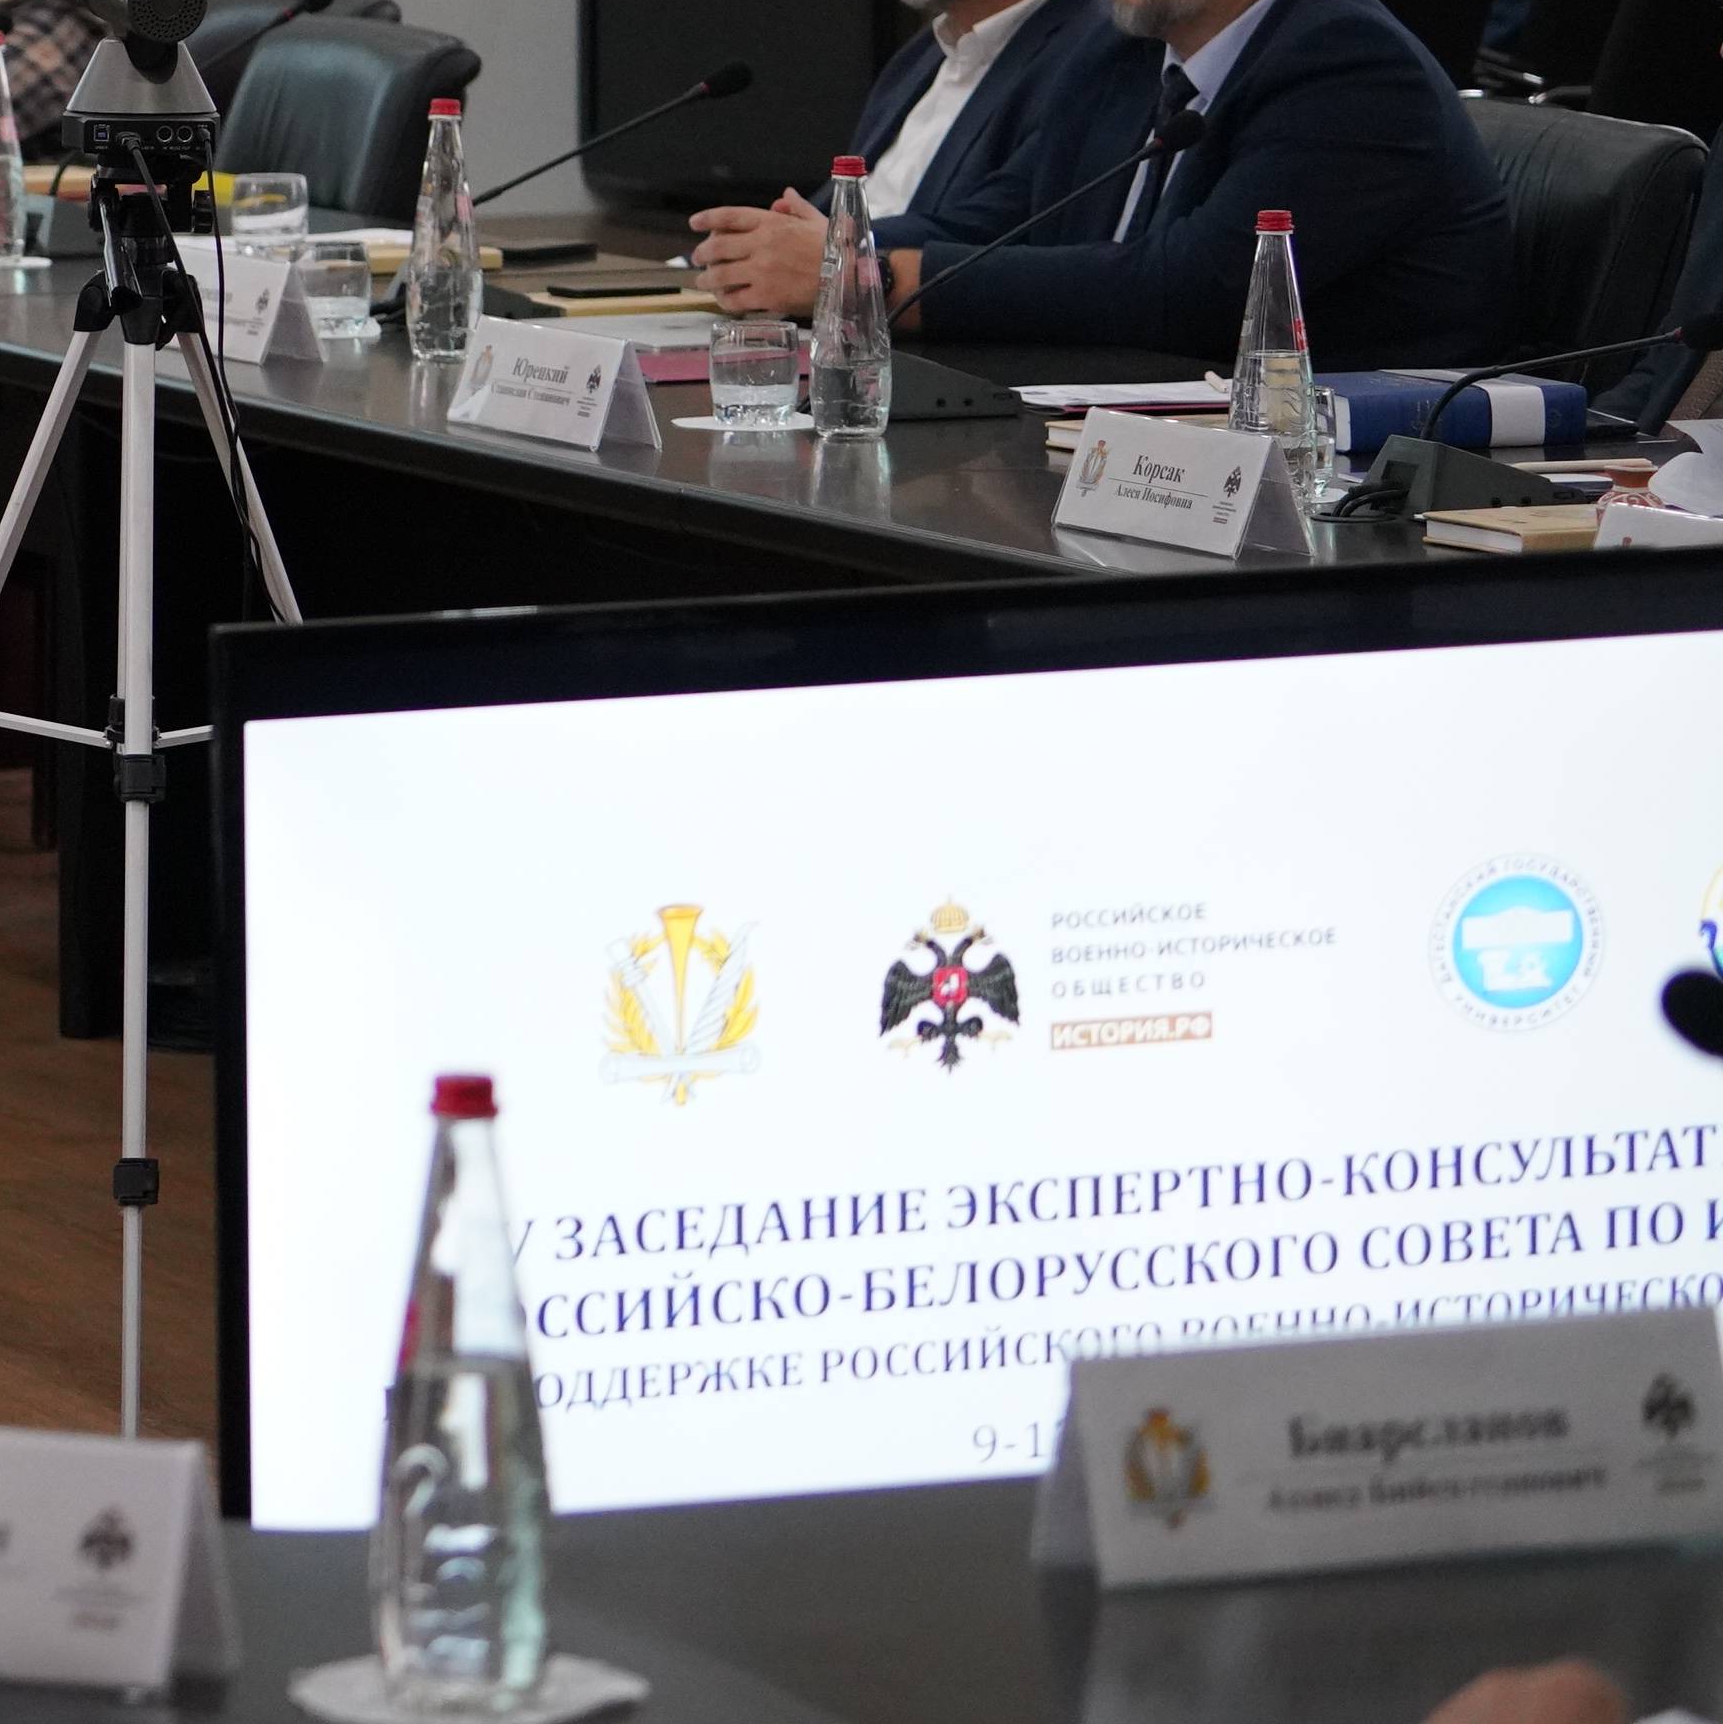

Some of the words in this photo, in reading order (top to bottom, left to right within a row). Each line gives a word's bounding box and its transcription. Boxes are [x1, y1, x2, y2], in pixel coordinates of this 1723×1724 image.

[512, 356, 570, 385] Юрецкий
[1132, 454, 1186, 484] Корсак
[1113, 484, 1141, 501] Алеся
[1142, 487, 1195, 510] Иосифовна
[1051, 901, 1206, 930] РОССИЙСКОЕ
[1051, 928, 1337, 965] ВОЕННО-ИСТОРИЧЕСКОЕ
[1051, 972, 1206, 999] ОБЩЕСТВО
[1053, 1015, 1210, 1047] ИСТОРИЯ.РФ
[554, 1187, 928, 1261] ЗАСЕДАНИЕ
[946, 1123, 1723, 1231] ЭКСПЕРТНО-КОНСУЛЬТАТ
[523, 1231, 1338, 1339] ССИЙСКО-БЕЛОРУССКОГО
[1360, 1212, 1584, 1268] СОВЕТА
[1604, 1202, 1685, 1249] ПО
[536, 1351, 803, 1413] ОДДЕРЖКЕ
[972, 1421, 1064, 1463] 9-1
